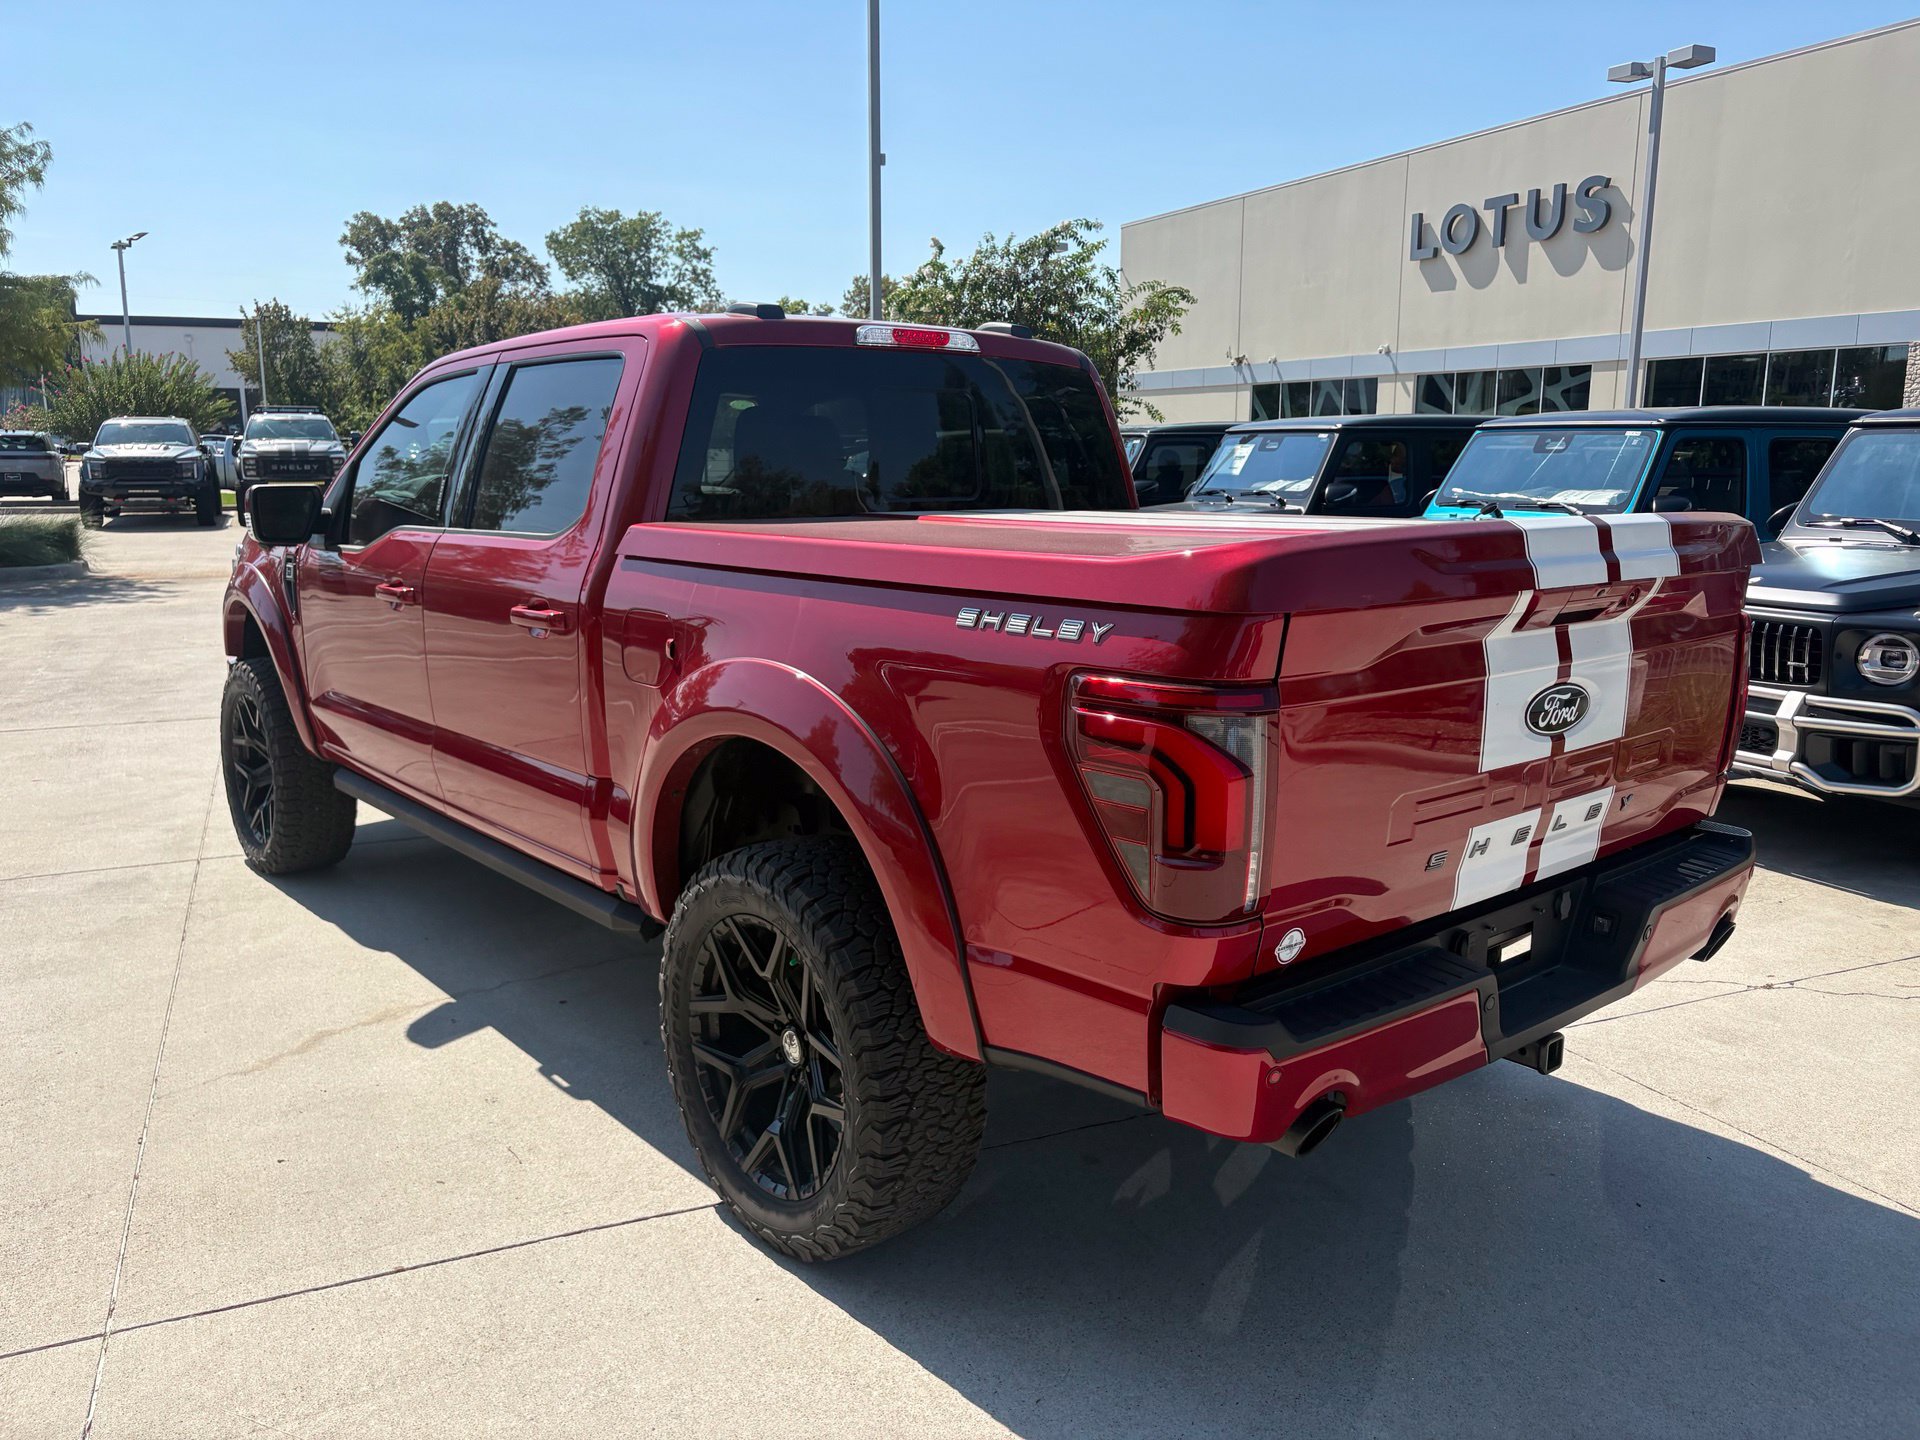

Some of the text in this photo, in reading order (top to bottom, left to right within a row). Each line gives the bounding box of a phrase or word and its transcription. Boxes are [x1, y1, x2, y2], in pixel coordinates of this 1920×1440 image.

[1410, 175, 1612, 261] LOTUS
[956, 607, 1115, 644] SHELBY
[1538, 692, 1582, 728] Ford
[1425, 793, 1634, 872] SHELBY
